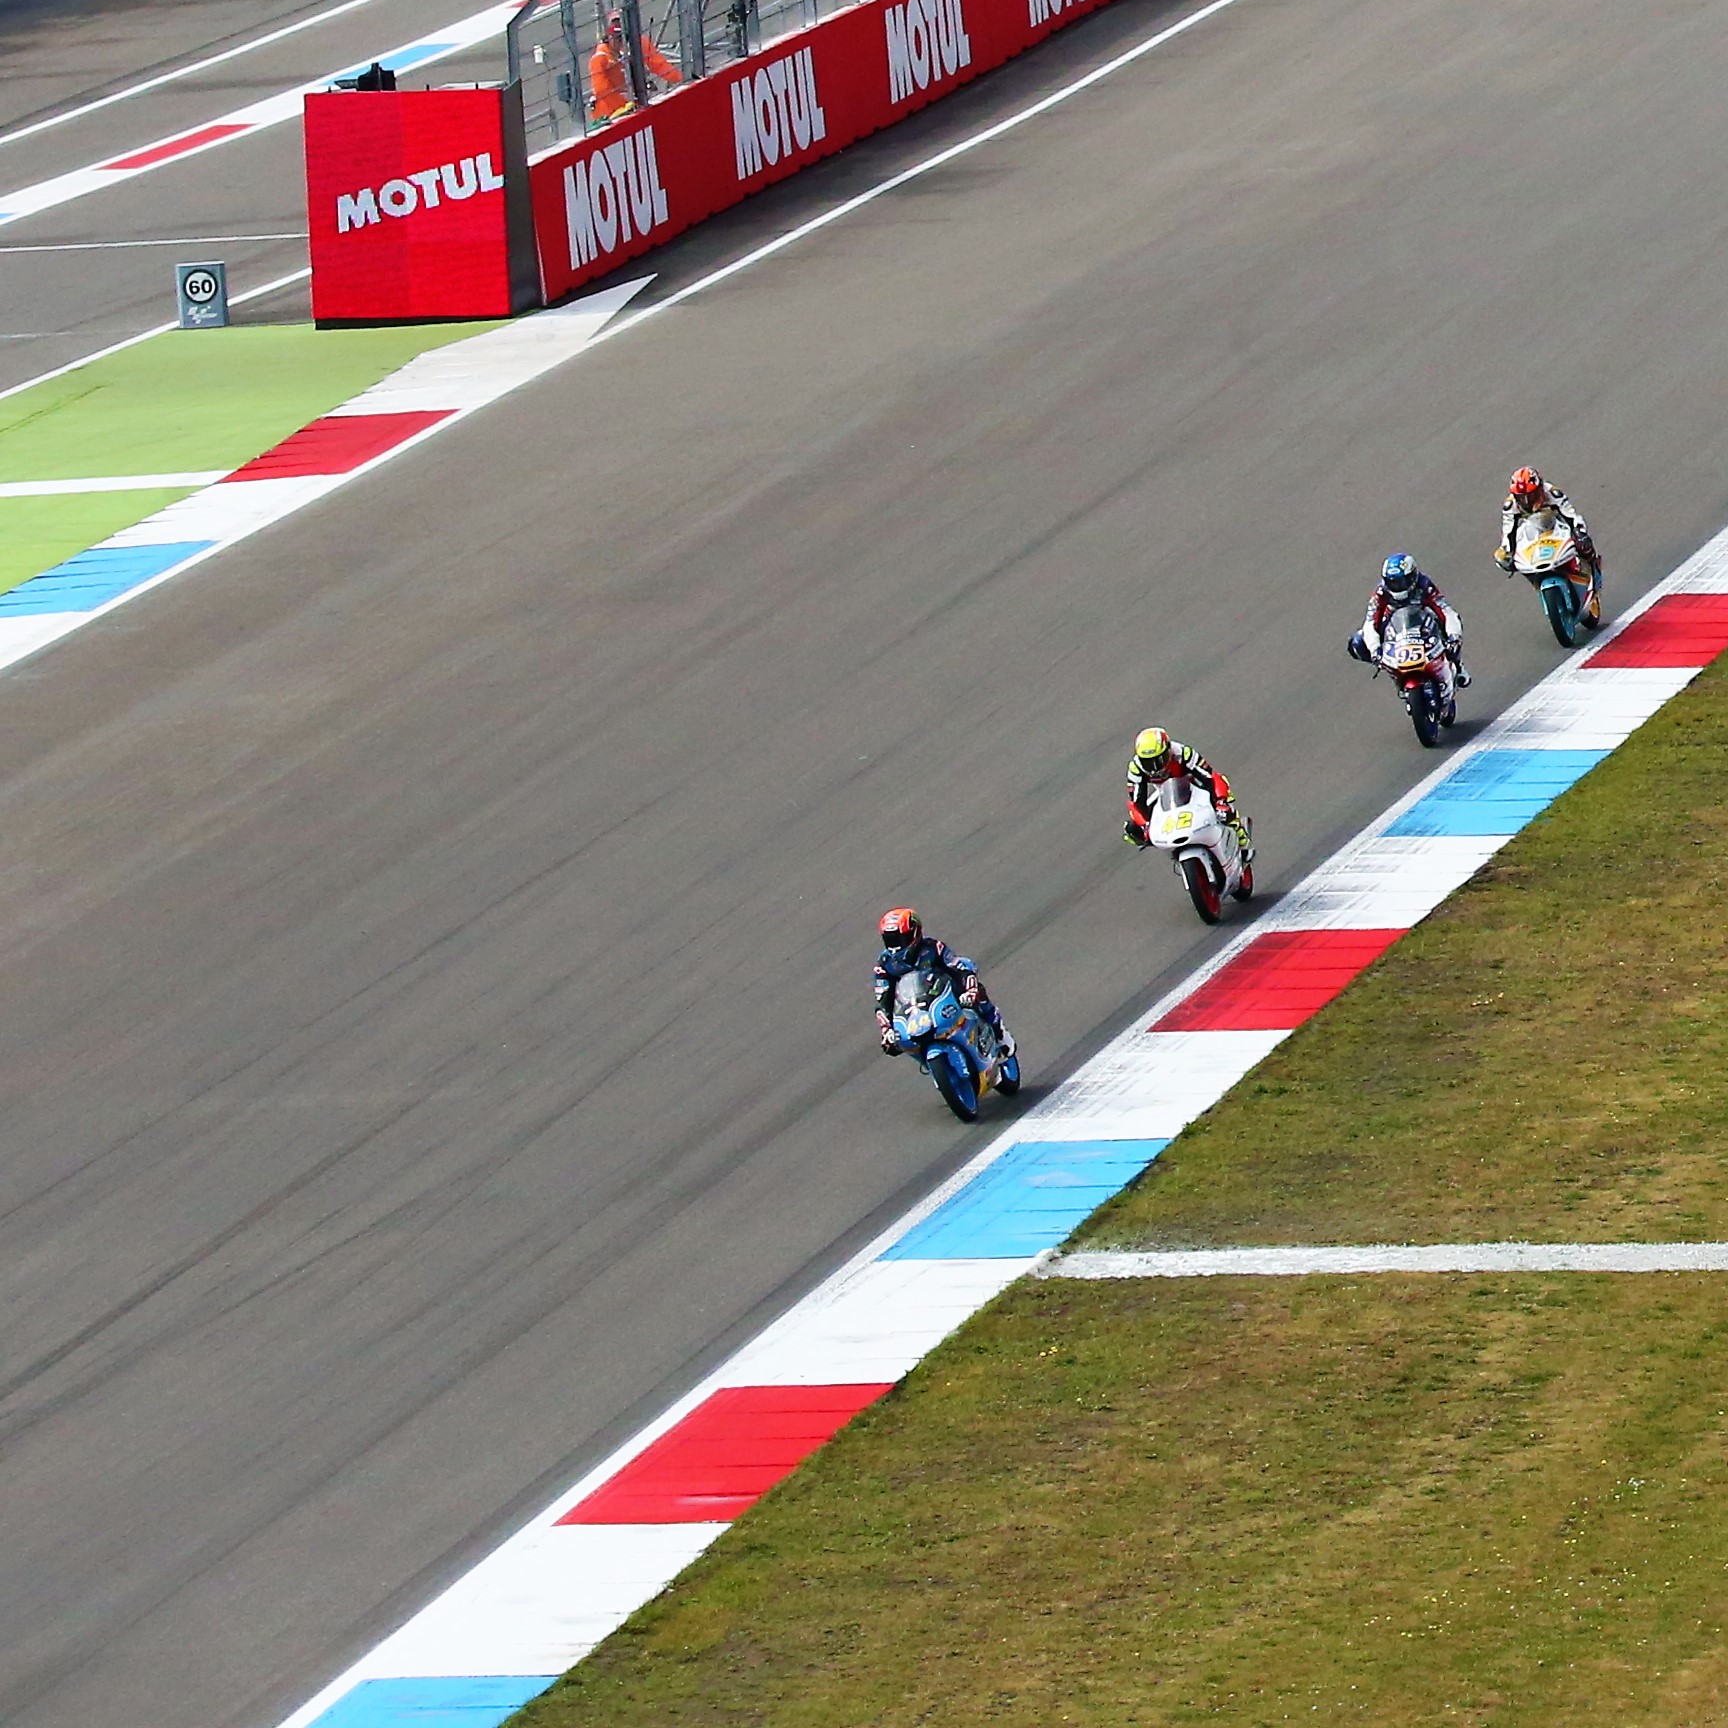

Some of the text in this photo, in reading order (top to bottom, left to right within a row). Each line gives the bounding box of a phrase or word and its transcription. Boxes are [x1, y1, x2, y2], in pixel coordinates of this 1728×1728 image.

[562, 125, 668, 270] MOTUL
[729, 46, 827, 181] MOTUL
[338, 153, 505, 233] MOTUL
[188, 279, 213, 295] 60
[1397, 647, 1422, 663] 95
